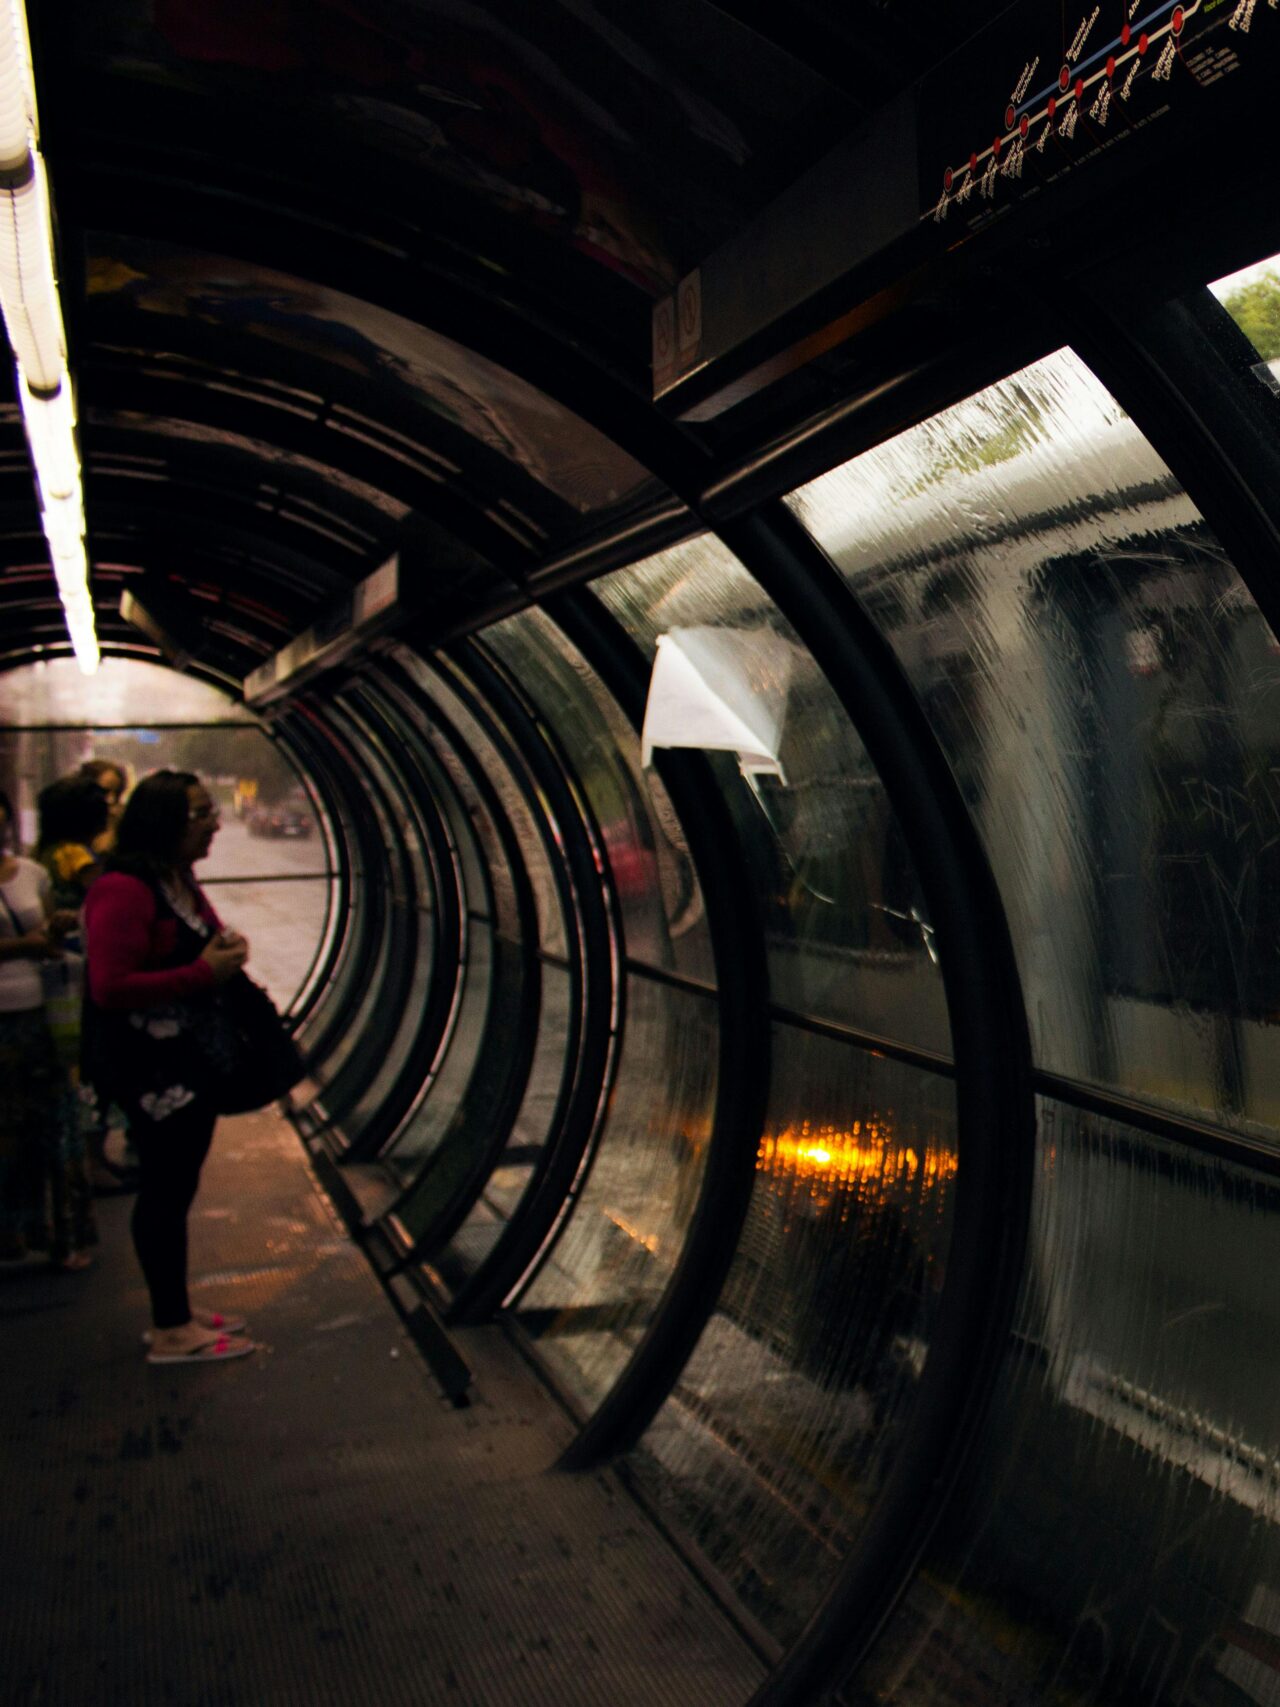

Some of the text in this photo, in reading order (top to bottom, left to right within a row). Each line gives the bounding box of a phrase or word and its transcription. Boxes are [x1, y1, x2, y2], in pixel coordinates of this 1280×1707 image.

[1151, 34, 1173, 81] Terminal
[1160, 43, 1177, 81] Cabral
[1036, 121, 1051, 154] Detran
